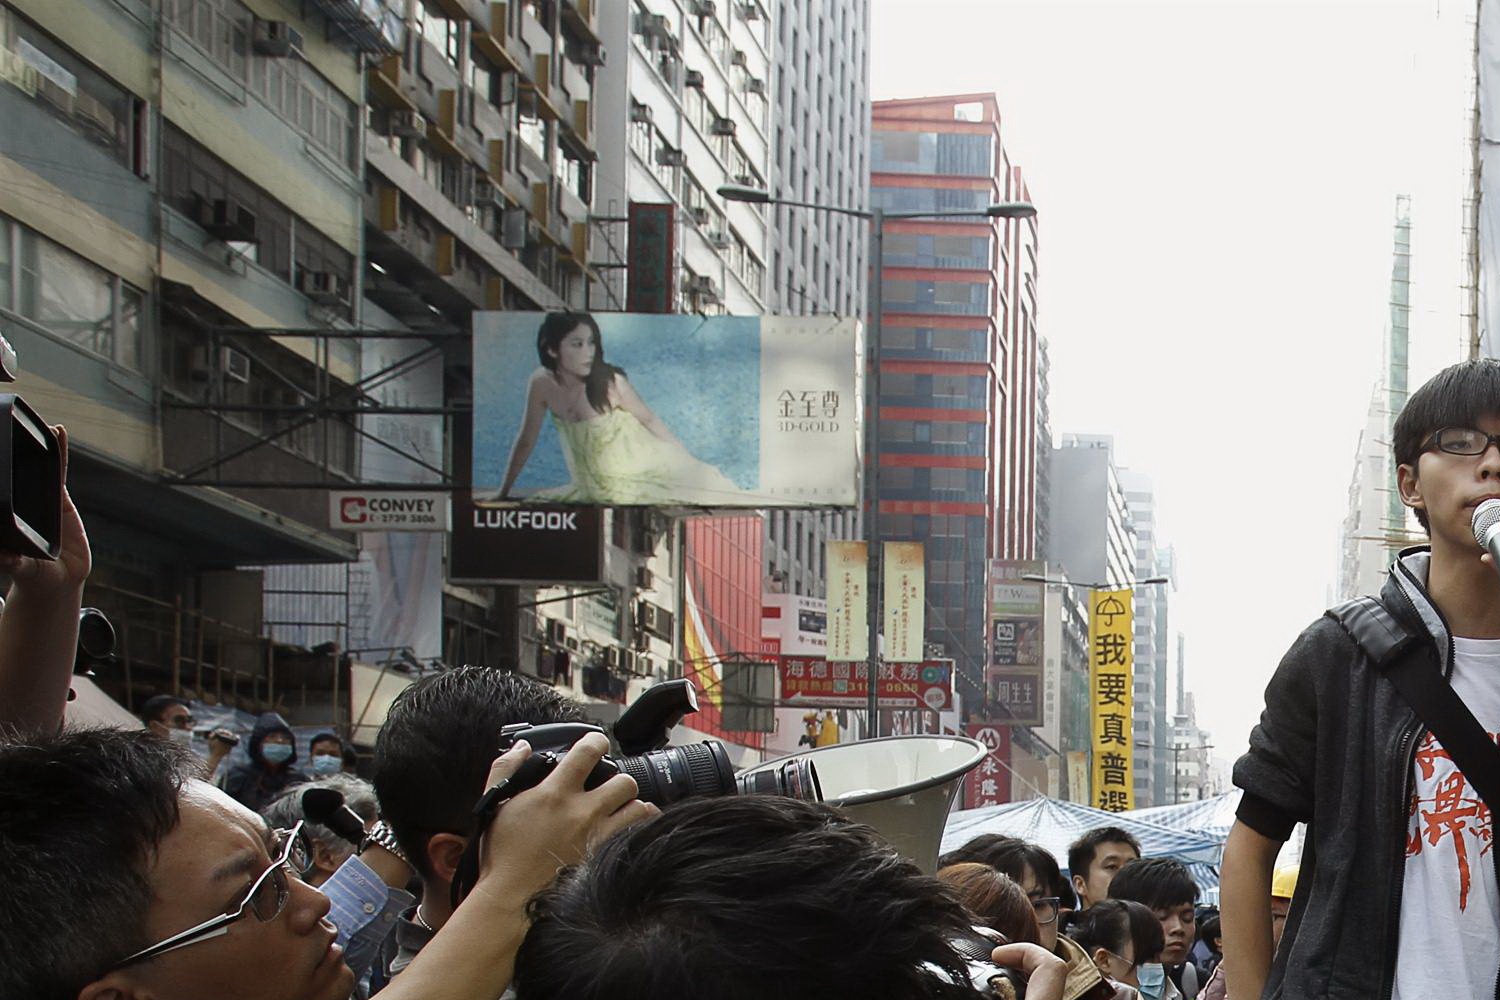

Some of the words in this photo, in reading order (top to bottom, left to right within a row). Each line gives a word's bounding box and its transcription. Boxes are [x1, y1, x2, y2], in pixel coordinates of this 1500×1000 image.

[777, 390, 840, 418] 金至尊
[368, 499, 435, 513] CONVEY
[473, 509, 577, 530] LUKFOOK
[1096, 633, 1129, 811] 我要真普選
